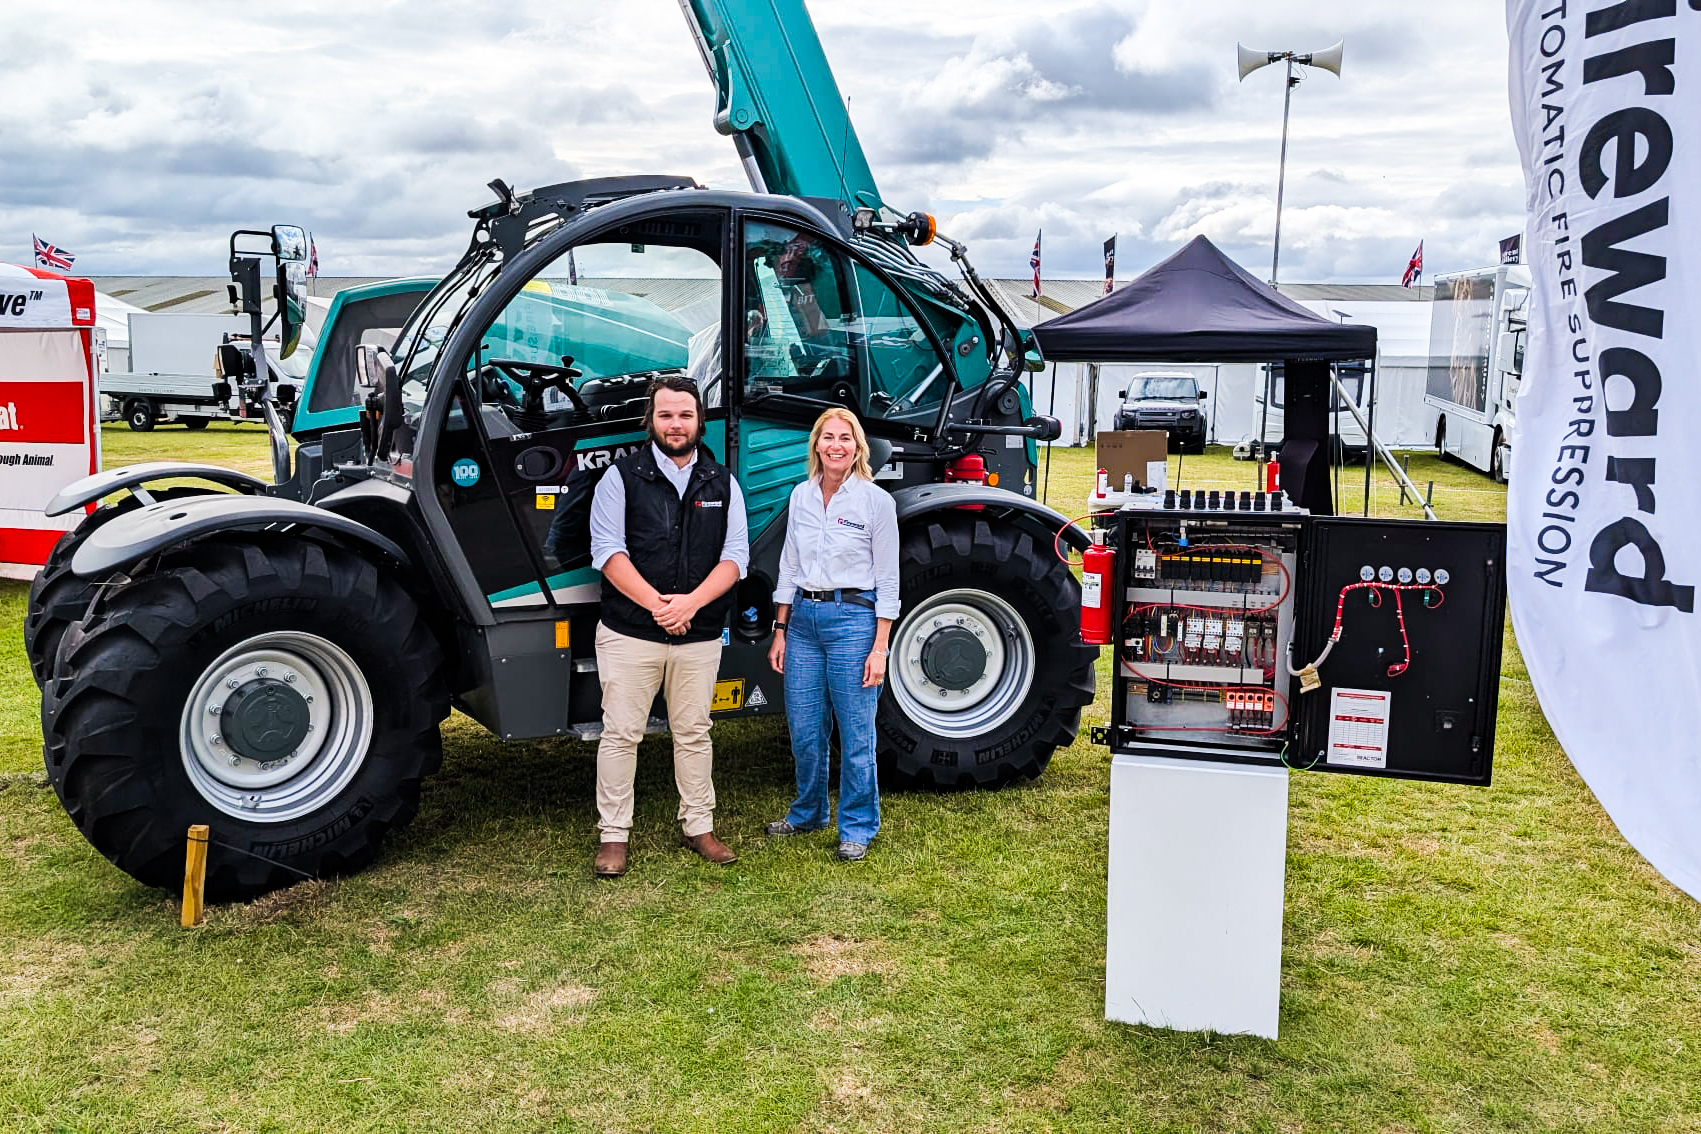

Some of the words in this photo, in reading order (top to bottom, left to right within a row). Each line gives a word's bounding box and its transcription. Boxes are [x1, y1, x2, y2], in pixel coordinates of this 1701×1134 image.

[1552, 212, 1577, 299] FIRE
[22, 454, 54, 466] Animal
[454, 465, 478, 480] 100
[1534, 313, 1595, 588] SUPPRESSION
[977, 712, 1044, 764] MICHELIN
[252, 815, 351, 857] MICHELIN
